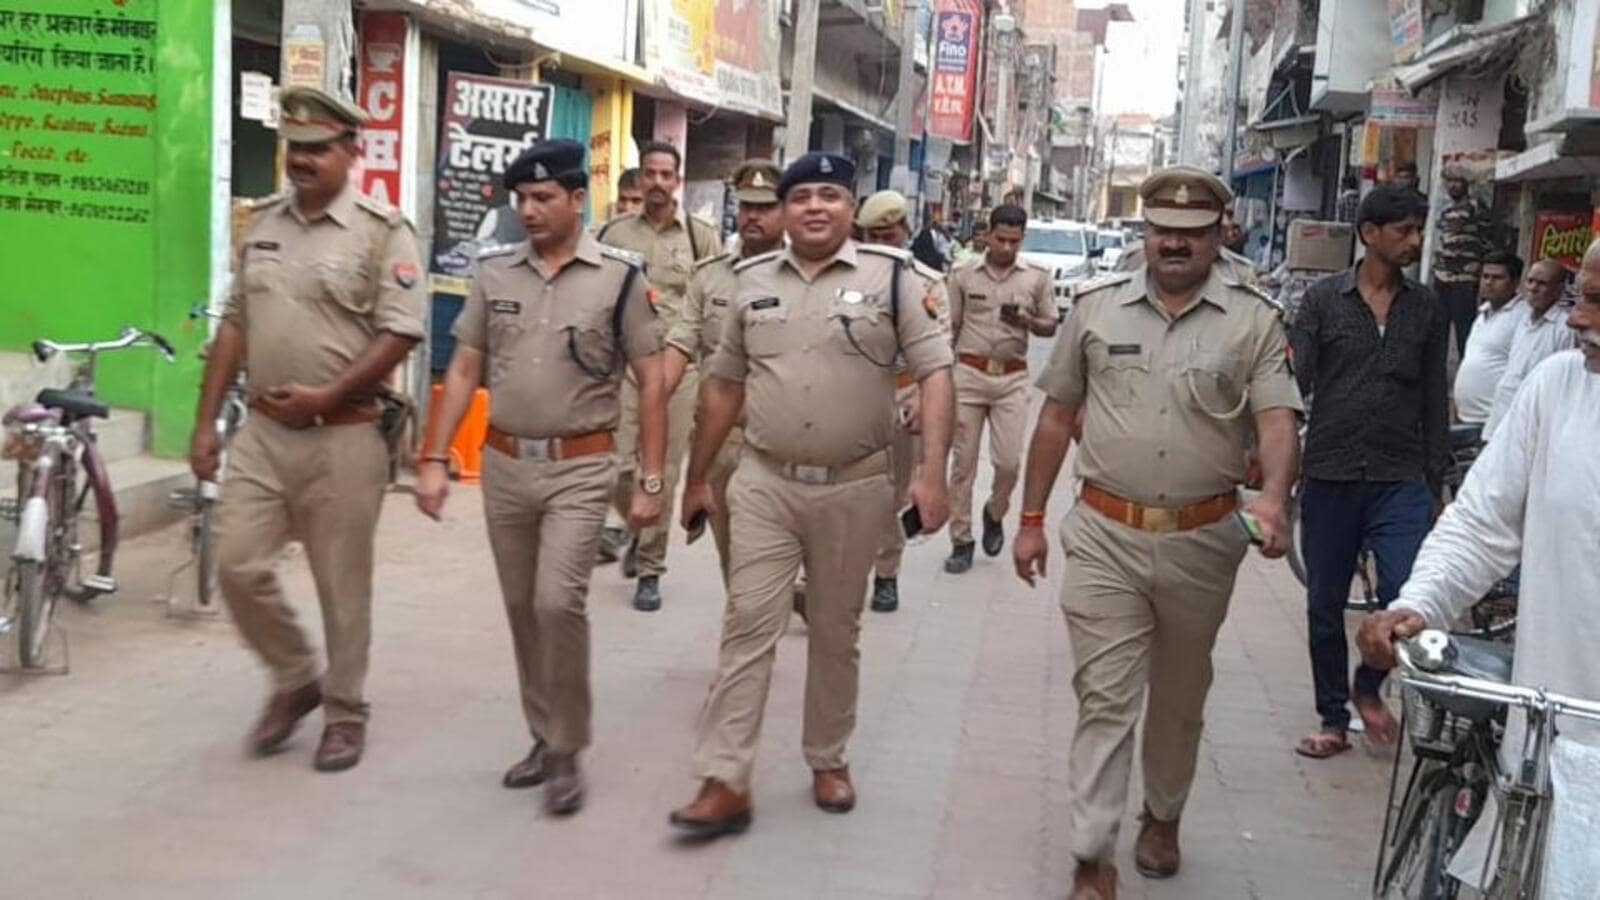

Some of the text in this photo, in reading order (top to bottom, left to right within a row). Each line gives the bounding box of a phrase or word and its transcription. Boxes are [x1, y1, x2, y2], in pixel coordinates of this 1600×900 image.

[51, 44, 92, 69] किया
[939, 40, 967, 56] Fino
[452, 80, 544, 126] असरार
